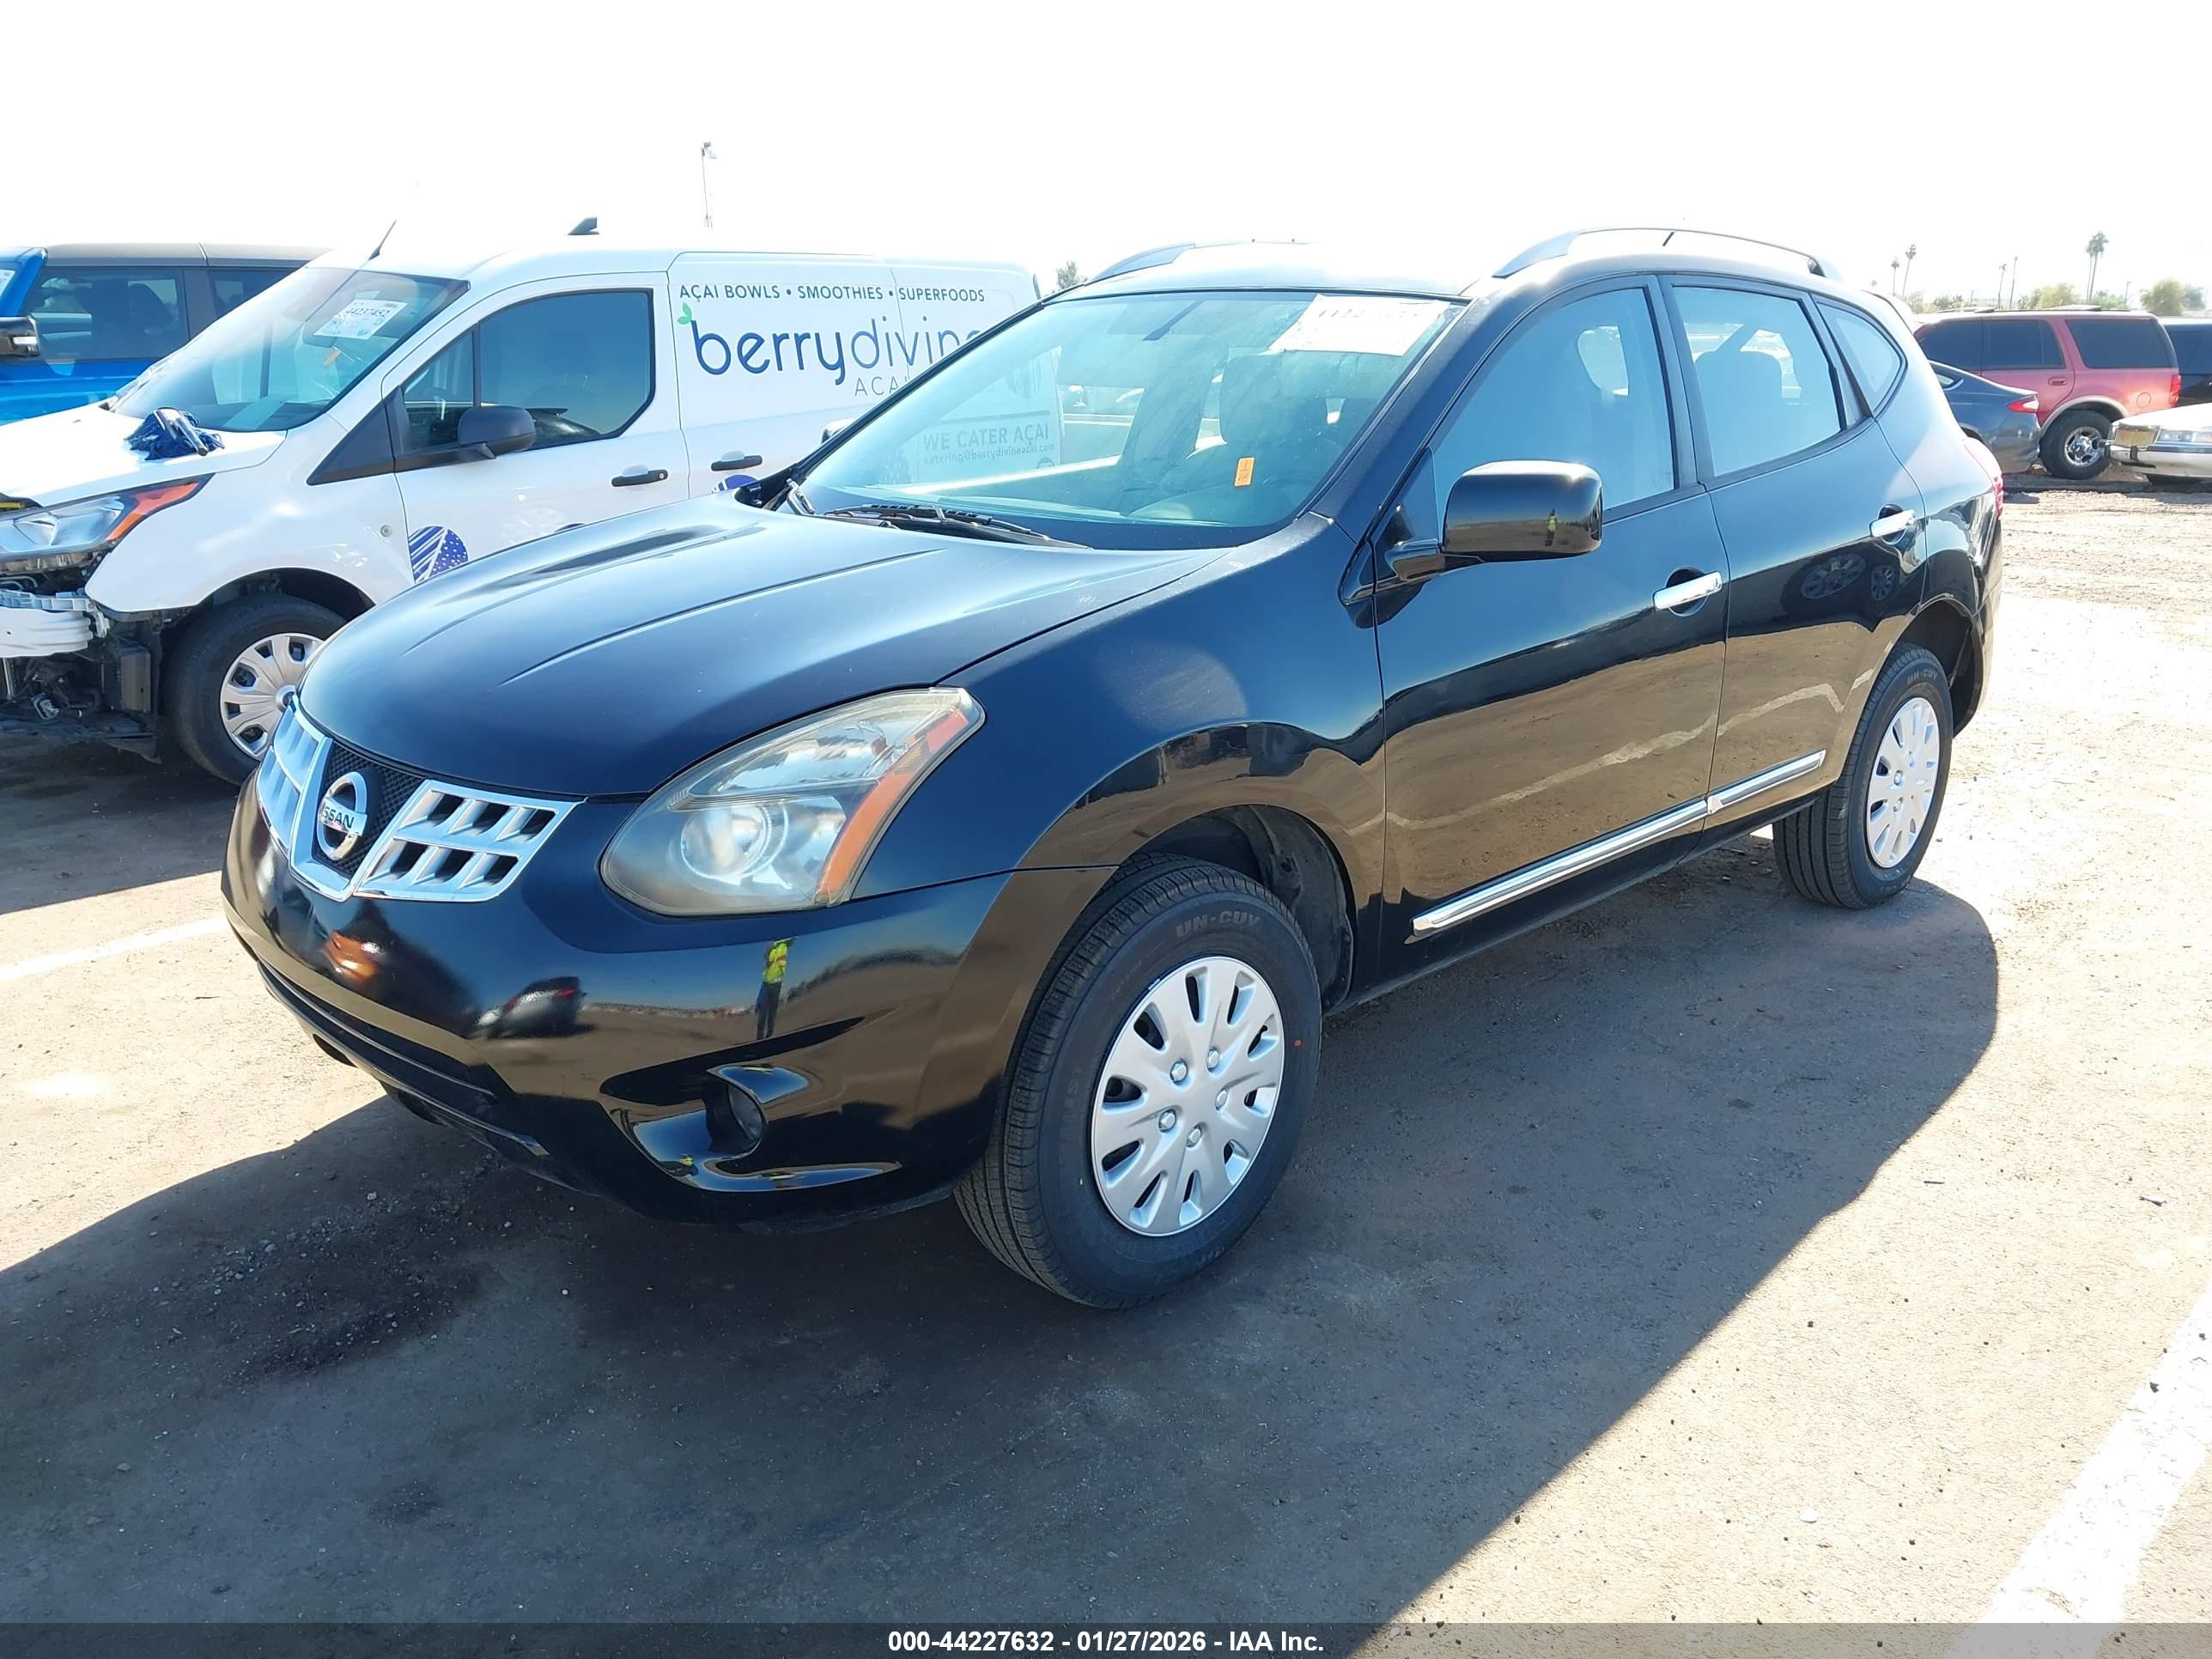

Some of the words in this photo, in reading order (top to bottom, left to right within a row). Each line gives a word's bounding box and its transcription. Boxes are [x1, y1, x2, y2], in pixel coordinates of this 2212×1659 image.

[680, 284, 719, 302] AÇAI
[725, 285, 781, 299] BOWLS
[798, 286, 883, 300] SMOOTHIES
[899, 288, 985, 301] SUPERFOODS
[923, 433, 951, 451] WE
[957, 428, 1007, 447] CATER
[1014, 423, 1048, 445] AÇAI
